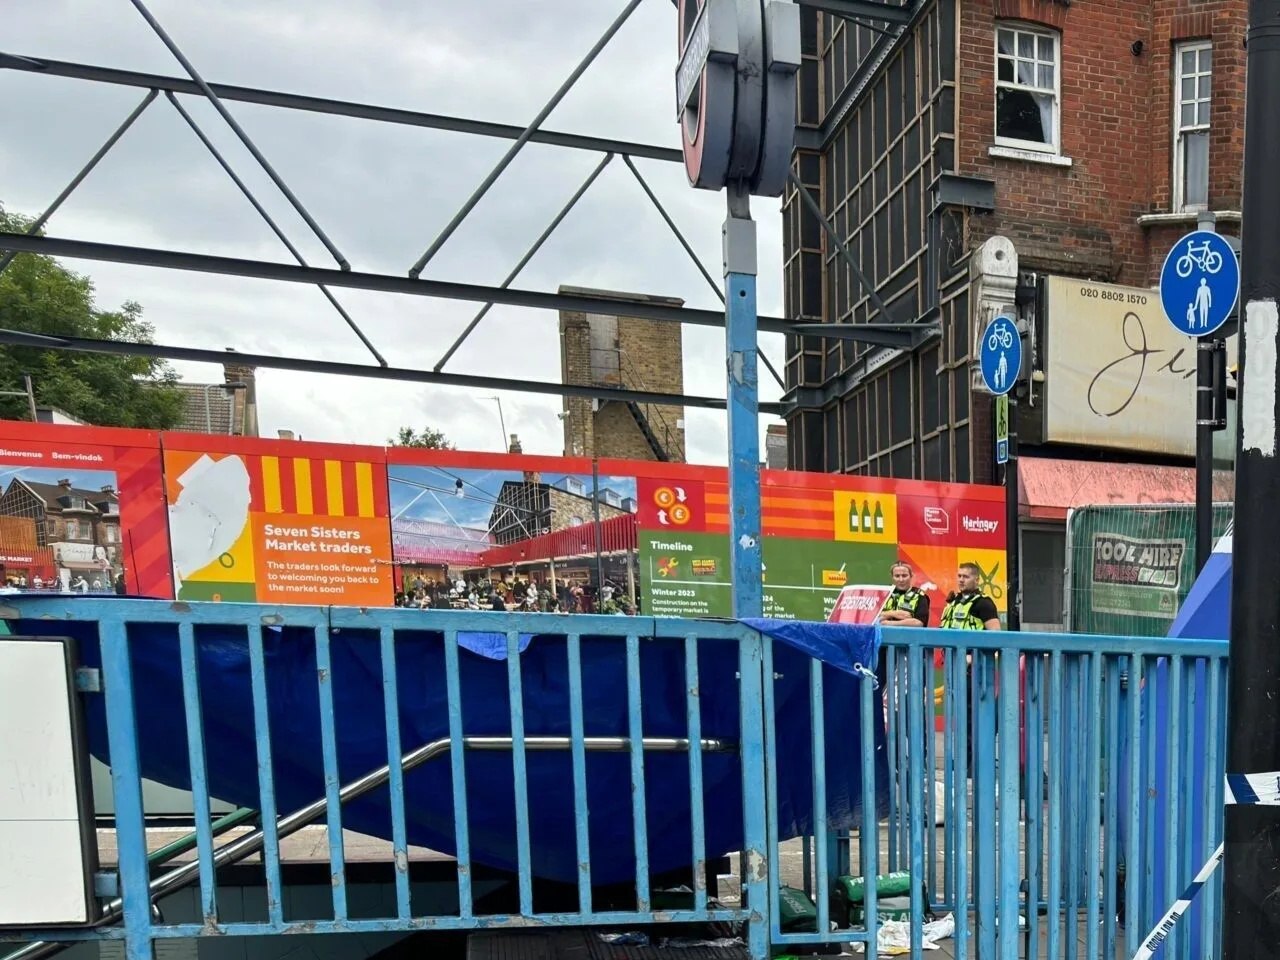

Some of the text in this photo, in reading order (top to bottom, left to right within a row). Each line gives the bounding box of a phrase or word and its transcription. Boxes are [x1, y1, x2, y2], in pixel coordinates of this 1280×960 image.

[1080, 288, 1148, 305] 020 8802 1570
[963, 515, 998, 533] Haringey
[264, 524, 361, 540] Seven Sisters
[266, 539, 372, 554] Market traders
[650, 540, 693, 552] Timeline
[1096, 541, 1181, 567] TOOL HIRE
[267, 561, 376, 573] The traders look forward
[268, 572, 379, 584] to welcoming you back to
[286, 584, 318, 592] market
[320, 586, 344, 594] soon!
[652, 588, 696, 598] Winter 2023
[652, 598, 690, 606] Construction
[652, 606, 682, 614] temporary
